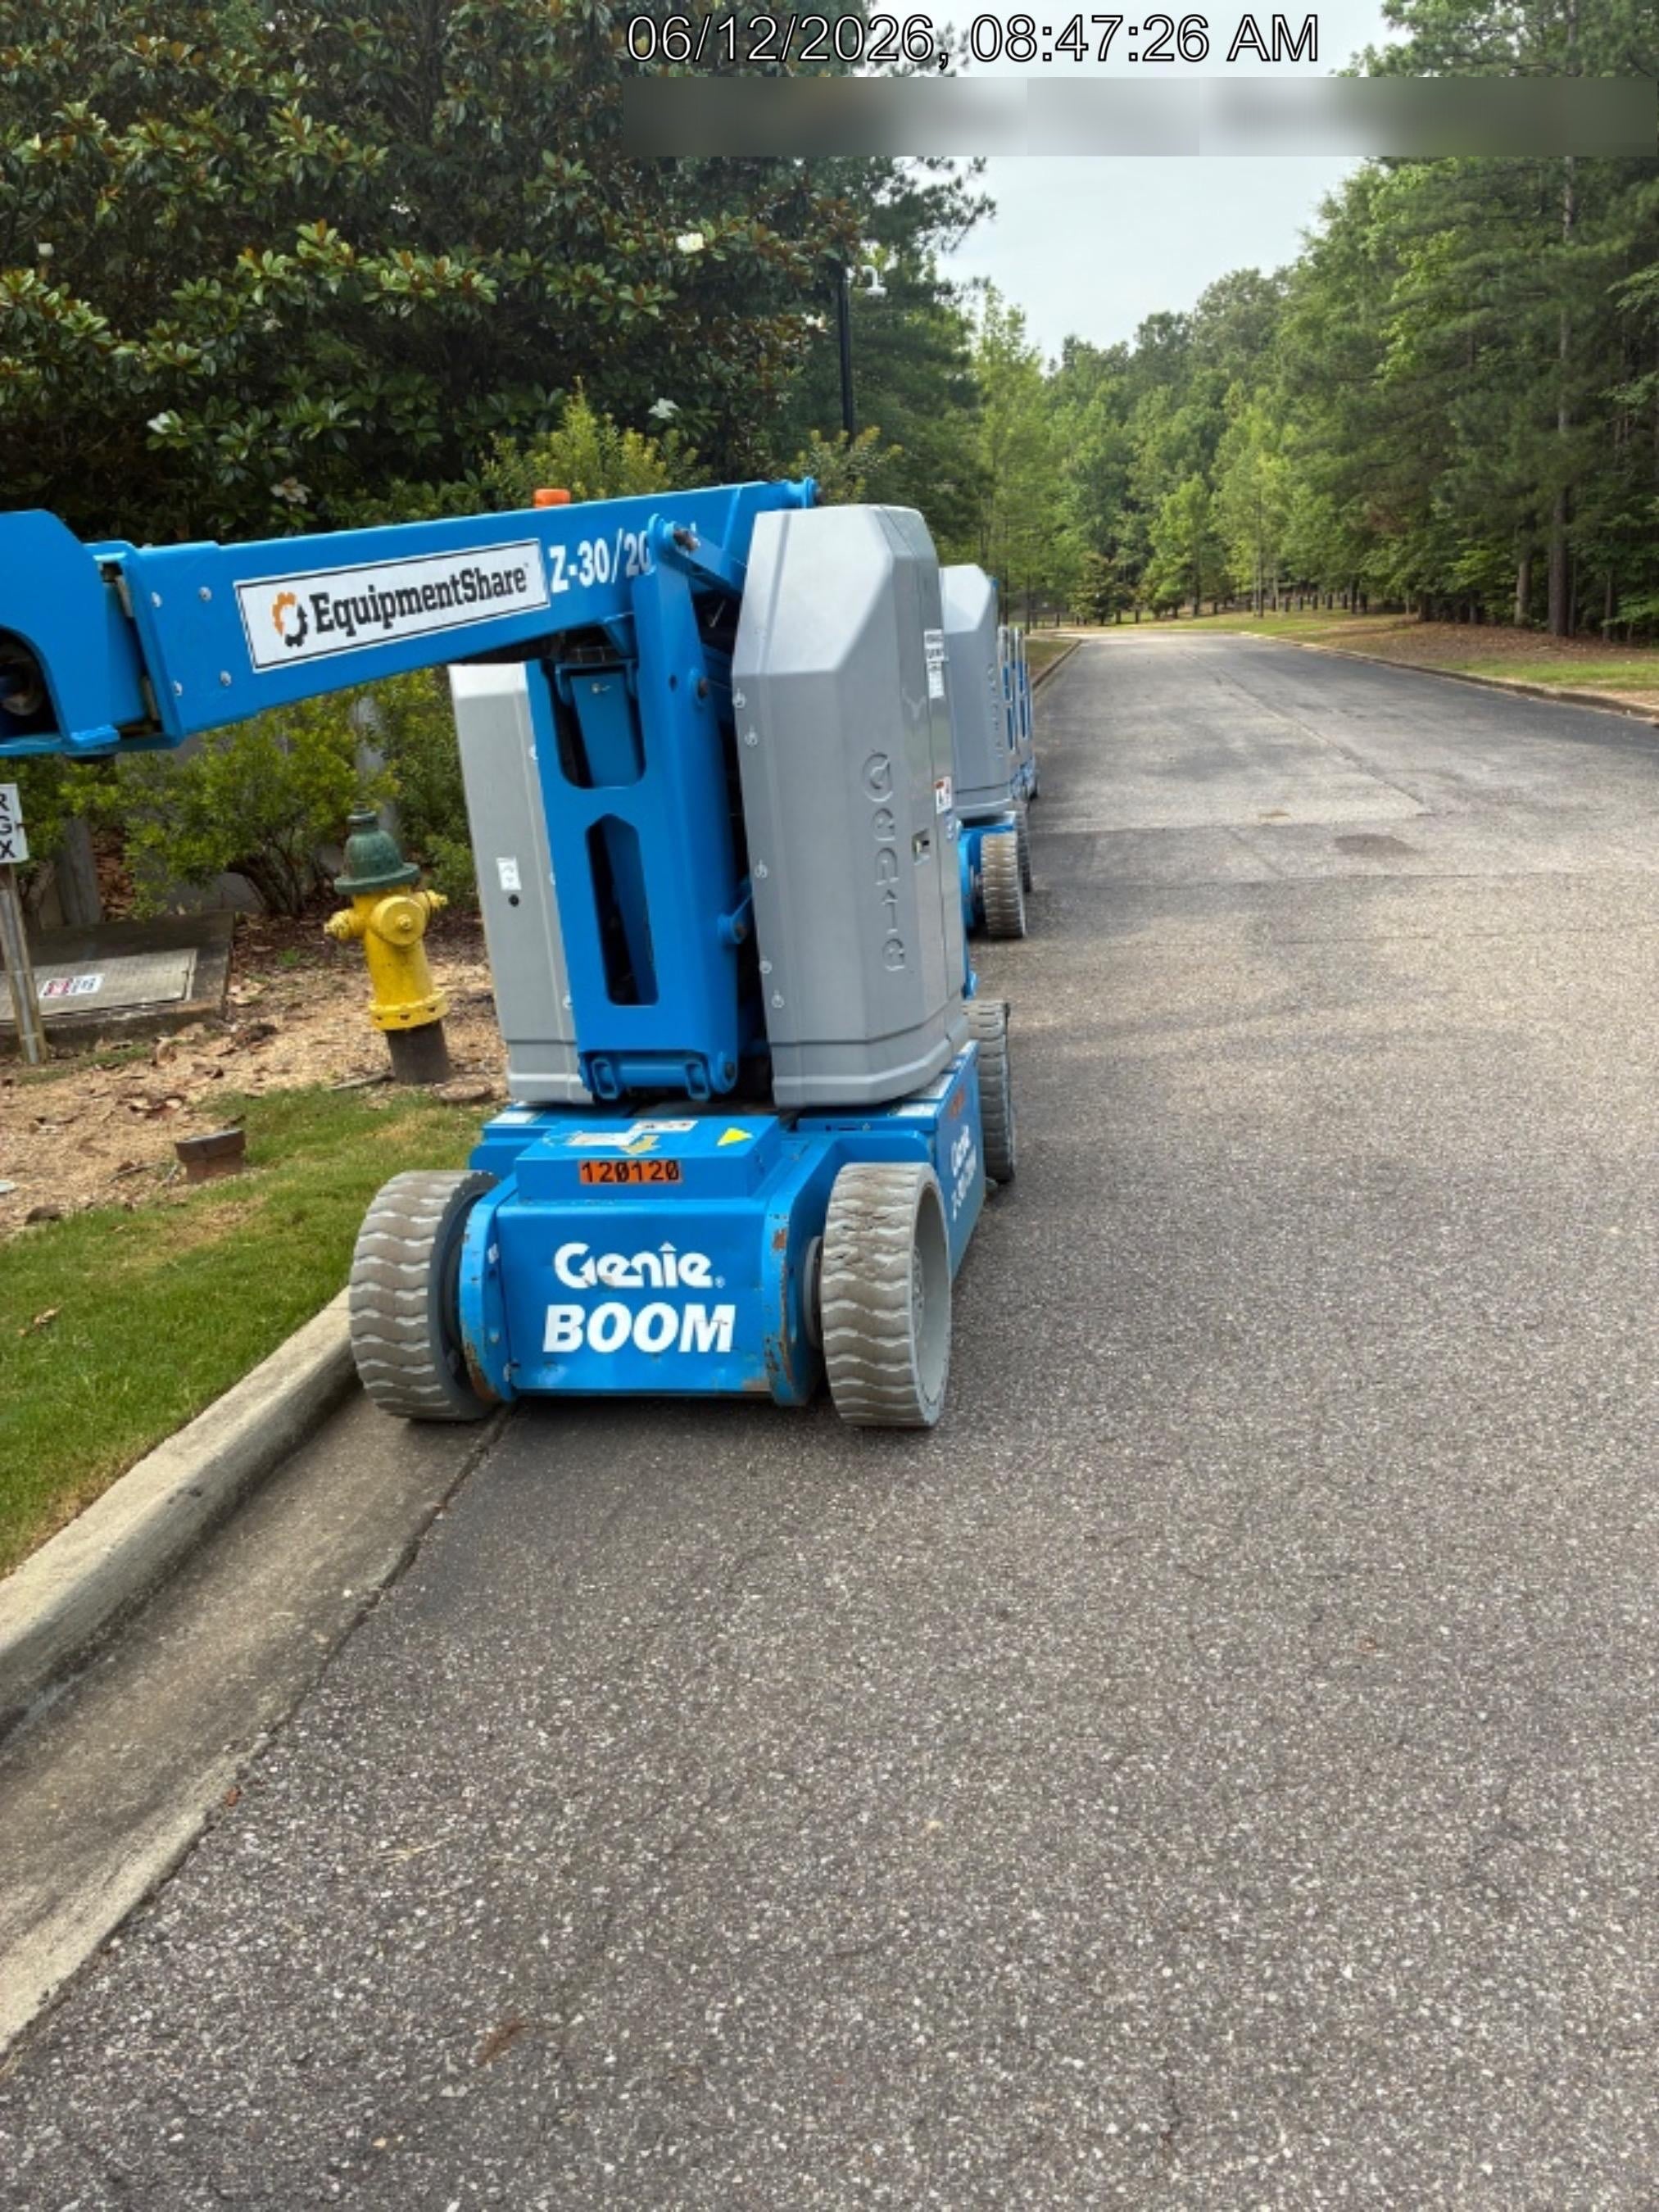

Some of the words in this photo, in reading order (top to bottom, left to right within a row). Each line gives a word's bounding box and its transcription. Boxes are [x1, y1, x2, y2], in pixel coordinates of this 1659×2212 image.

[310, 567, 527, 637] EquipmentShare
[581, 1161, 680, 1183] 120120
[554, 1241, 714, 1289] Genie
[542, 1301, 736, 1353] BOOM
